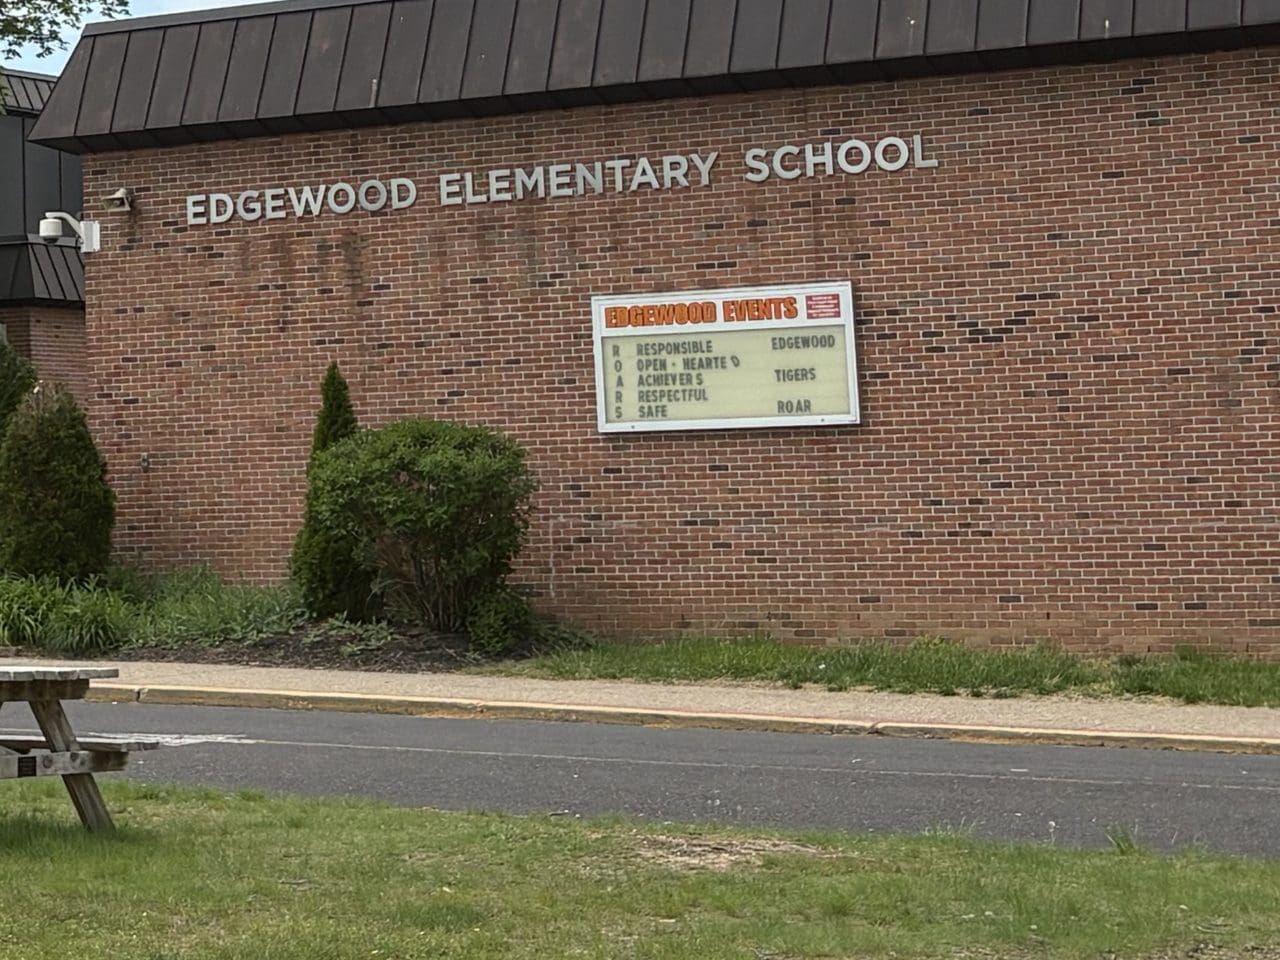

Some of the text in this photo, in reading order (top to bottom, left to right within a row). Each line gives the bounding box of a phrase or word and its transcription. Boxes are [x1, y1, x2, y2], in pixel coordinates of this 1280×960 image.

[185, 134, 940, 226] EDGEWOOD ELEMENTARY SCHOOL
[604, 301, 717, 329] EDGEWOOD
[722, 296, 799, 323] EVENTS
[612, 340, 713, 357] R RESPONSIBLE
[771, 334, 836, 351] EDGEWOOD
[614, 359, 622, 373] O
[636, 358, 667, 372] OPEN
[616, 373, 704, 388] A ACHIEVERS
[774, 367, 817, 383] TIGERS
[615, 388, 708, 404] R RESPECTFUL
[615, 404, 668, 419] S SAFE
[777, 399, 812, 414] ROAR
